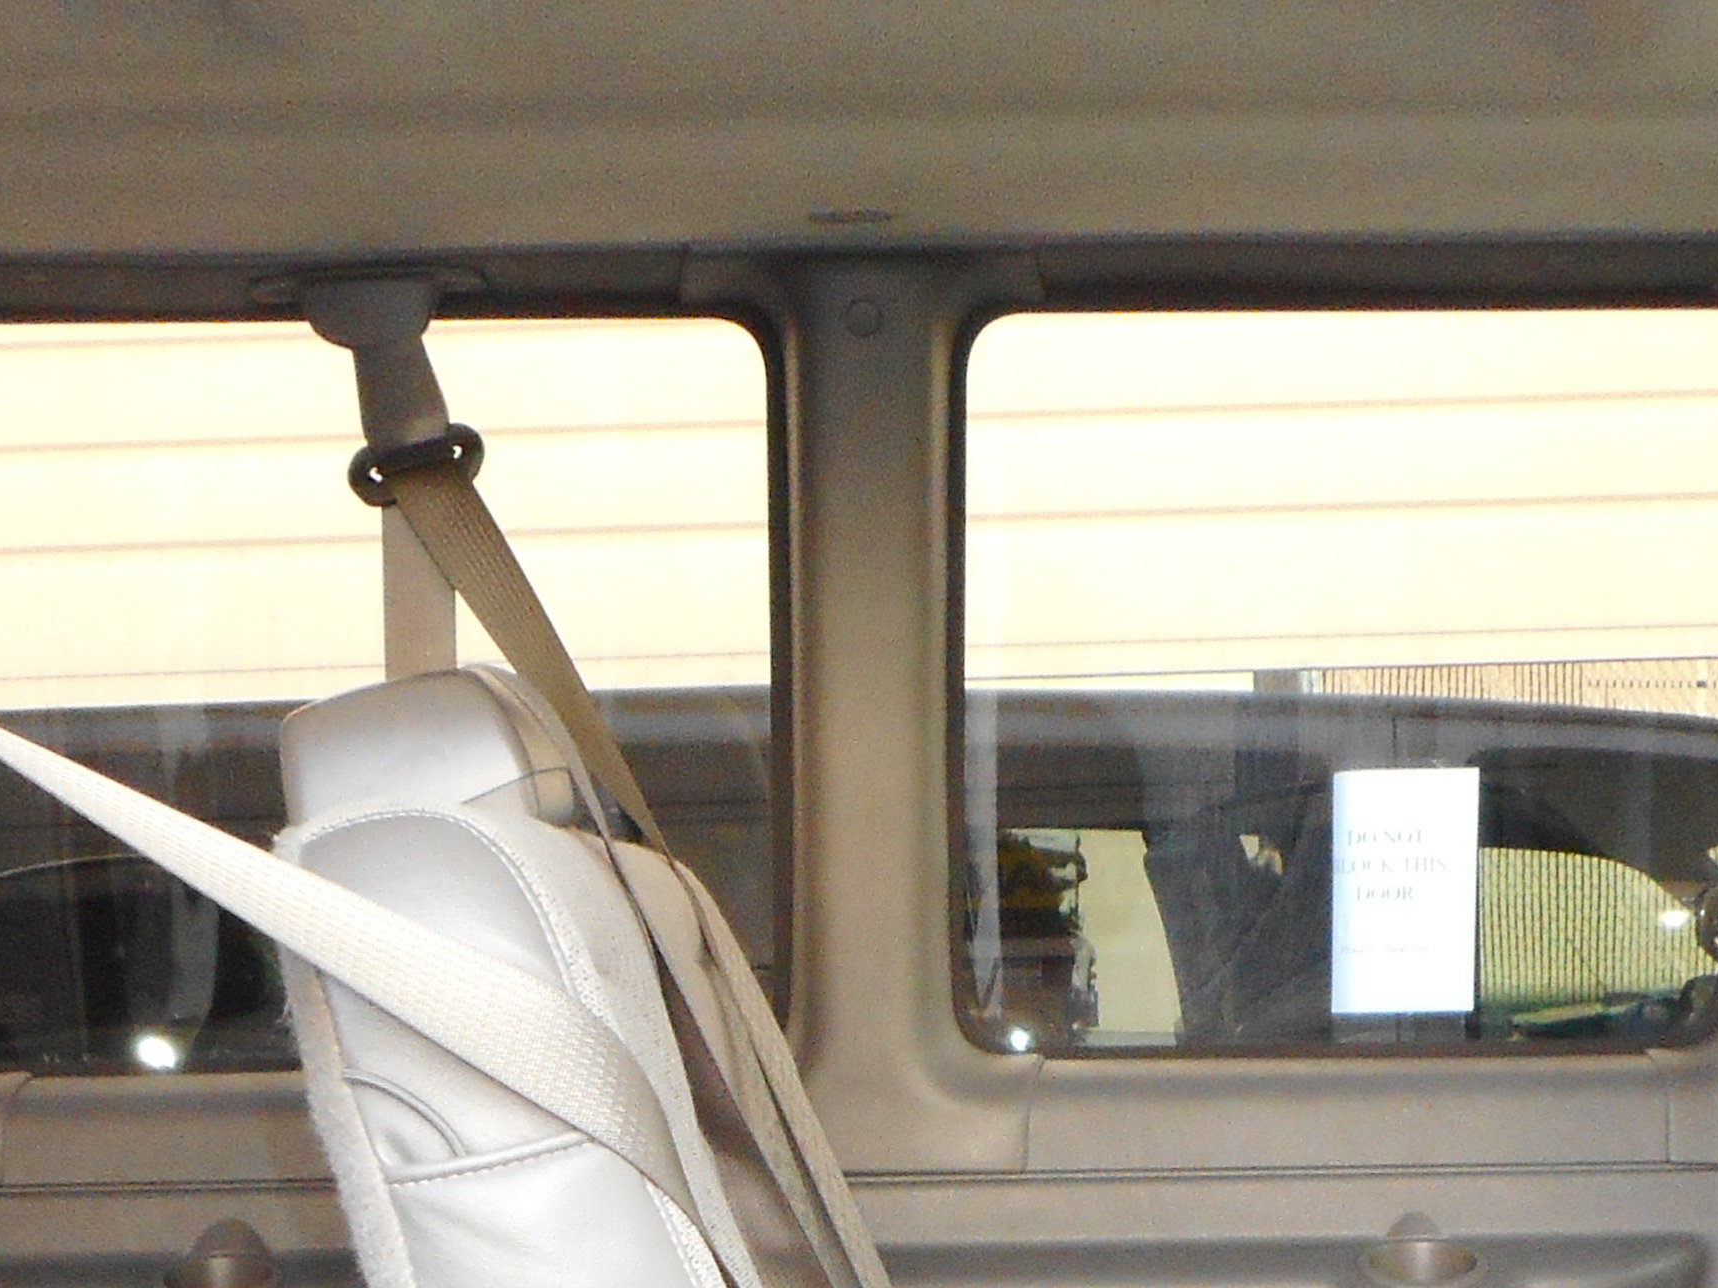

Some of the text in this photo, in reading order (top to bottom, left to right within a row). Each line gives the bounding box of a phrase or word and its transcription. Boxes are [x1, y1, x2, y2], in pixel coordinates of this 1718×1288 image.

[1347, 828, 1426, 847] DO NOT
[1402, 856, 1447, 873] THIS
[1356, 884, 1415, 902] DOOR
